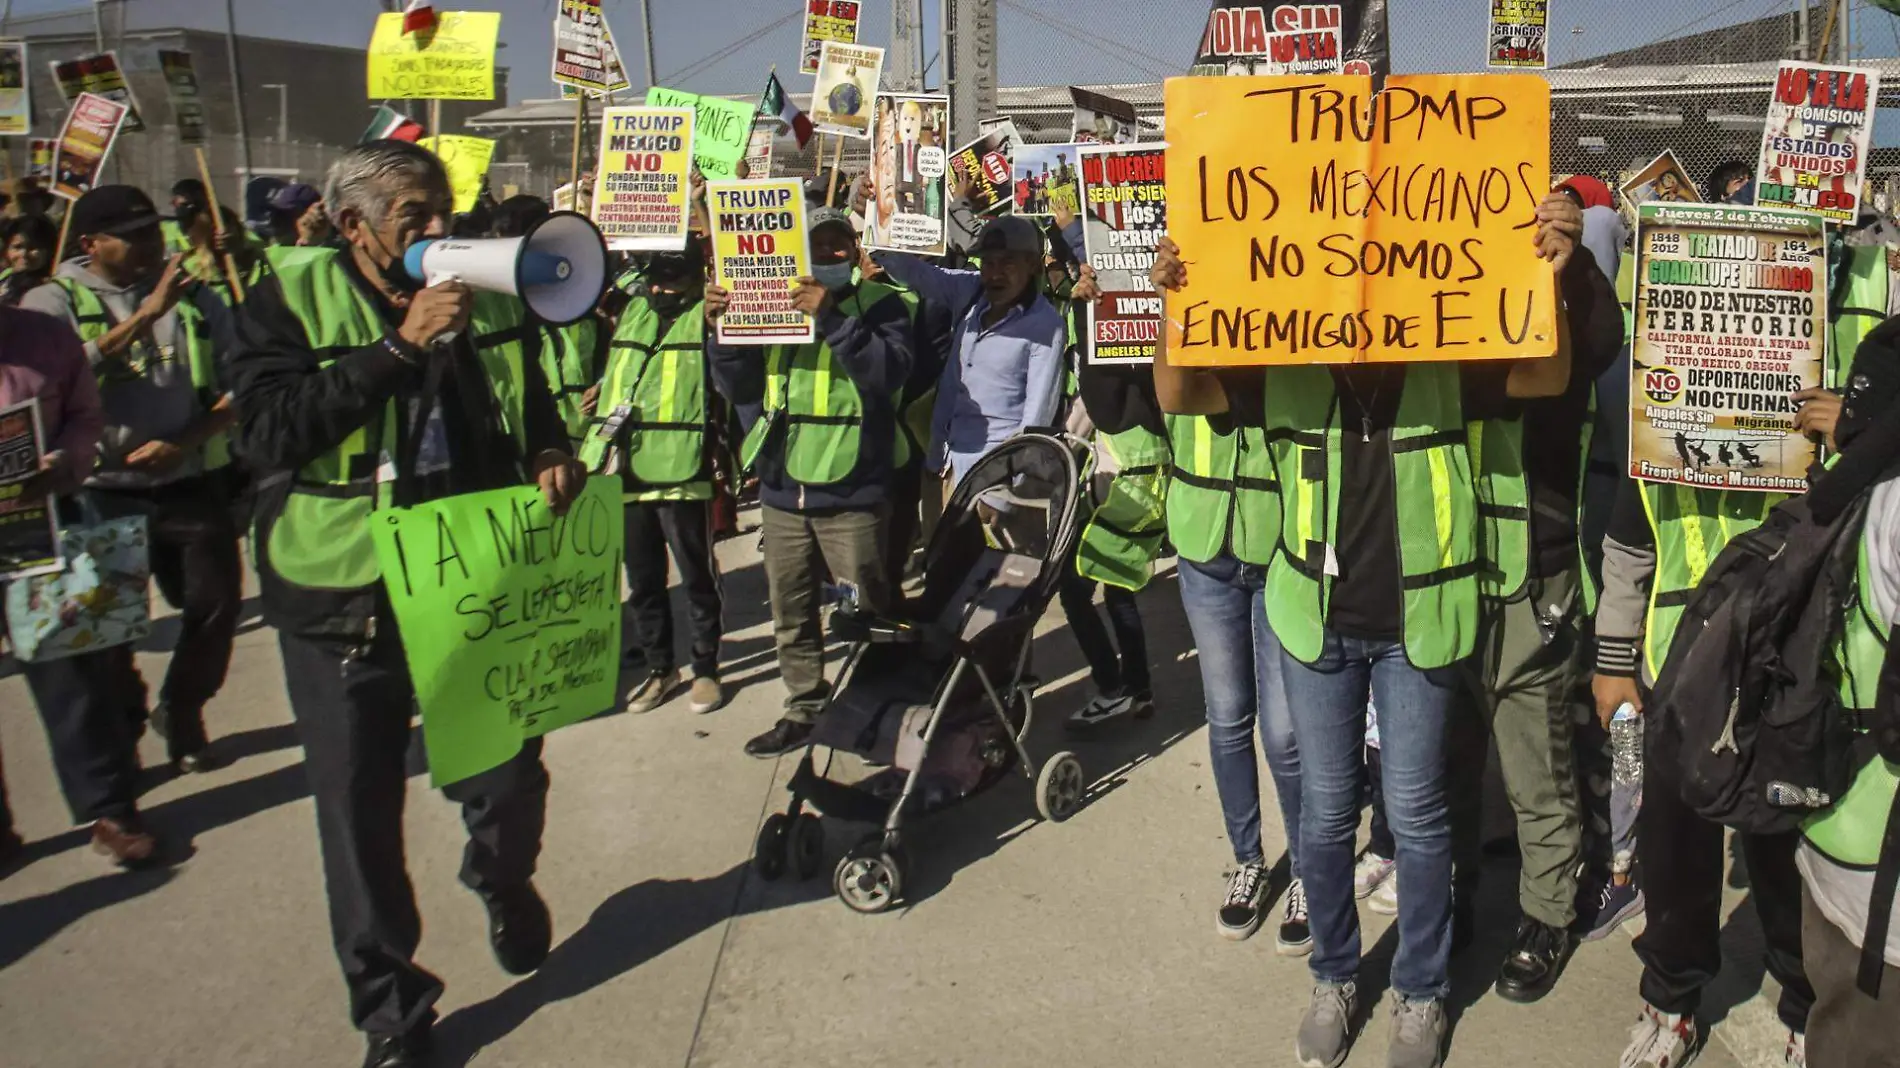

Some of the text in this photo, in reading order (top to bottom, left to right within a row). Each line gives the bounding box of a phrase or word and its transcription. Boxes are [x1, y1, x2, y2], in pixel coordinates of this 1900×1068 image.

[1214, 8, 1266, 55] DIA
[1494, 26, 1544, 36] GRINGOS
[1270, 32, 1336, 62] NO A LA
[1510, 38, 1527, 48] GO
[382, 75, 410, 93] NO
[1775, 68, 1866, 110] NO A LA
[613, 116, 684, 130] TRUMP
[1244, 84, 1507, 144] TRUPMP
[1804, 124, 1826, 138] DE
[1774, 138, 1852, 158] ESTADOS
[626, 153, 662, 172] NO
[986, 154, 1008, 184] ALTO
[1084, 154, 1164, 185] NO QUEREM
[1777, 154, 1844, 174] UNIDOS
[608, 173, 678, 182] PONDRA MURO EN
[1798, 173, 1819, 186] EN
[606, 182, 678, 192] SU FRONTERA SUR
[1088, 186, 1135, 203] SEGUIR
[1138, 185, 1166, 202] SIEN
[1199, 156, 1539, 230] LOS MEXICANOS
[614, 194, 668, 203] BIENVENIDOS
[717, 189, 791, 208] TRUMP
[1760, 183, 1854, 210] MEXICO
[640, 204, 680, 213] HERMANOS
[1122, 206, 1156, 224] LOS
[1654, 208, 1809, 226] Jueves 2 de Febrero
[1700, 220, 1752, 229] Internacional
[738, 234, 776, 255] NO
[1108, 230, 1166, 247] PERRO
[1652, 234, 1680, 242] 1848
[1783, 240, 1807, 251] 164
[1652, 244, 1679, 254] 2012
[1688, 233, 1776, 262] TRATADO DE
[724, 256, 796, 266] PONDRA MURO EN
[1250, 234, 1484, 282] NO SOMOS
[1780, 252, 1810, 263] Años
[724, 267, 798, 278] SU FRONTERA SUR
[1649, 260, 1813, 292] GUADALUPE HIDALGO
[734, 280, 788, 290] BIENVENIDOS
[729, 292, 790, 302] ESTROS HERMA
[1646, 289, 1813, 316] ROBO DE NUESTRO
[728, 302, 792, 313] ENTROAMERICA
[724, 315, 732, 324] EN
[734, 314, 742, 324] SU
[744, 314, 760, 324] PASO
[762, 314, 784, 324] HACIA
[1181, 301, 1374, 354] ENEMIGOS
[1383, 314, 1420, 348] DE
[1646, 311, 1813, 338] TERRITORIO
[1097, 346, 1141, 358] ANGELES
[1770, 340, 1811, 350] NEVADA
[1664, 356, 1698, 368] NUEVO
[1759, 350, 1792, 360] TEXAS
[1646, 373, 1681, 392] NO
[1688, 369, 1801, 392] DEPORTACIONES
[1685, 390, 1801, 414] NOCTURNAS
[1646, 405, 1715, 424] Angeles Sin
[1734, 416, 1793, 430] Migrante
[1652, 418, 1707, 432] Fronteras
[1641, 461, 1680, 479] Frente
[1728, 471, 1808, 489] Mexicalense
[456, 594, 517, 641] SE
